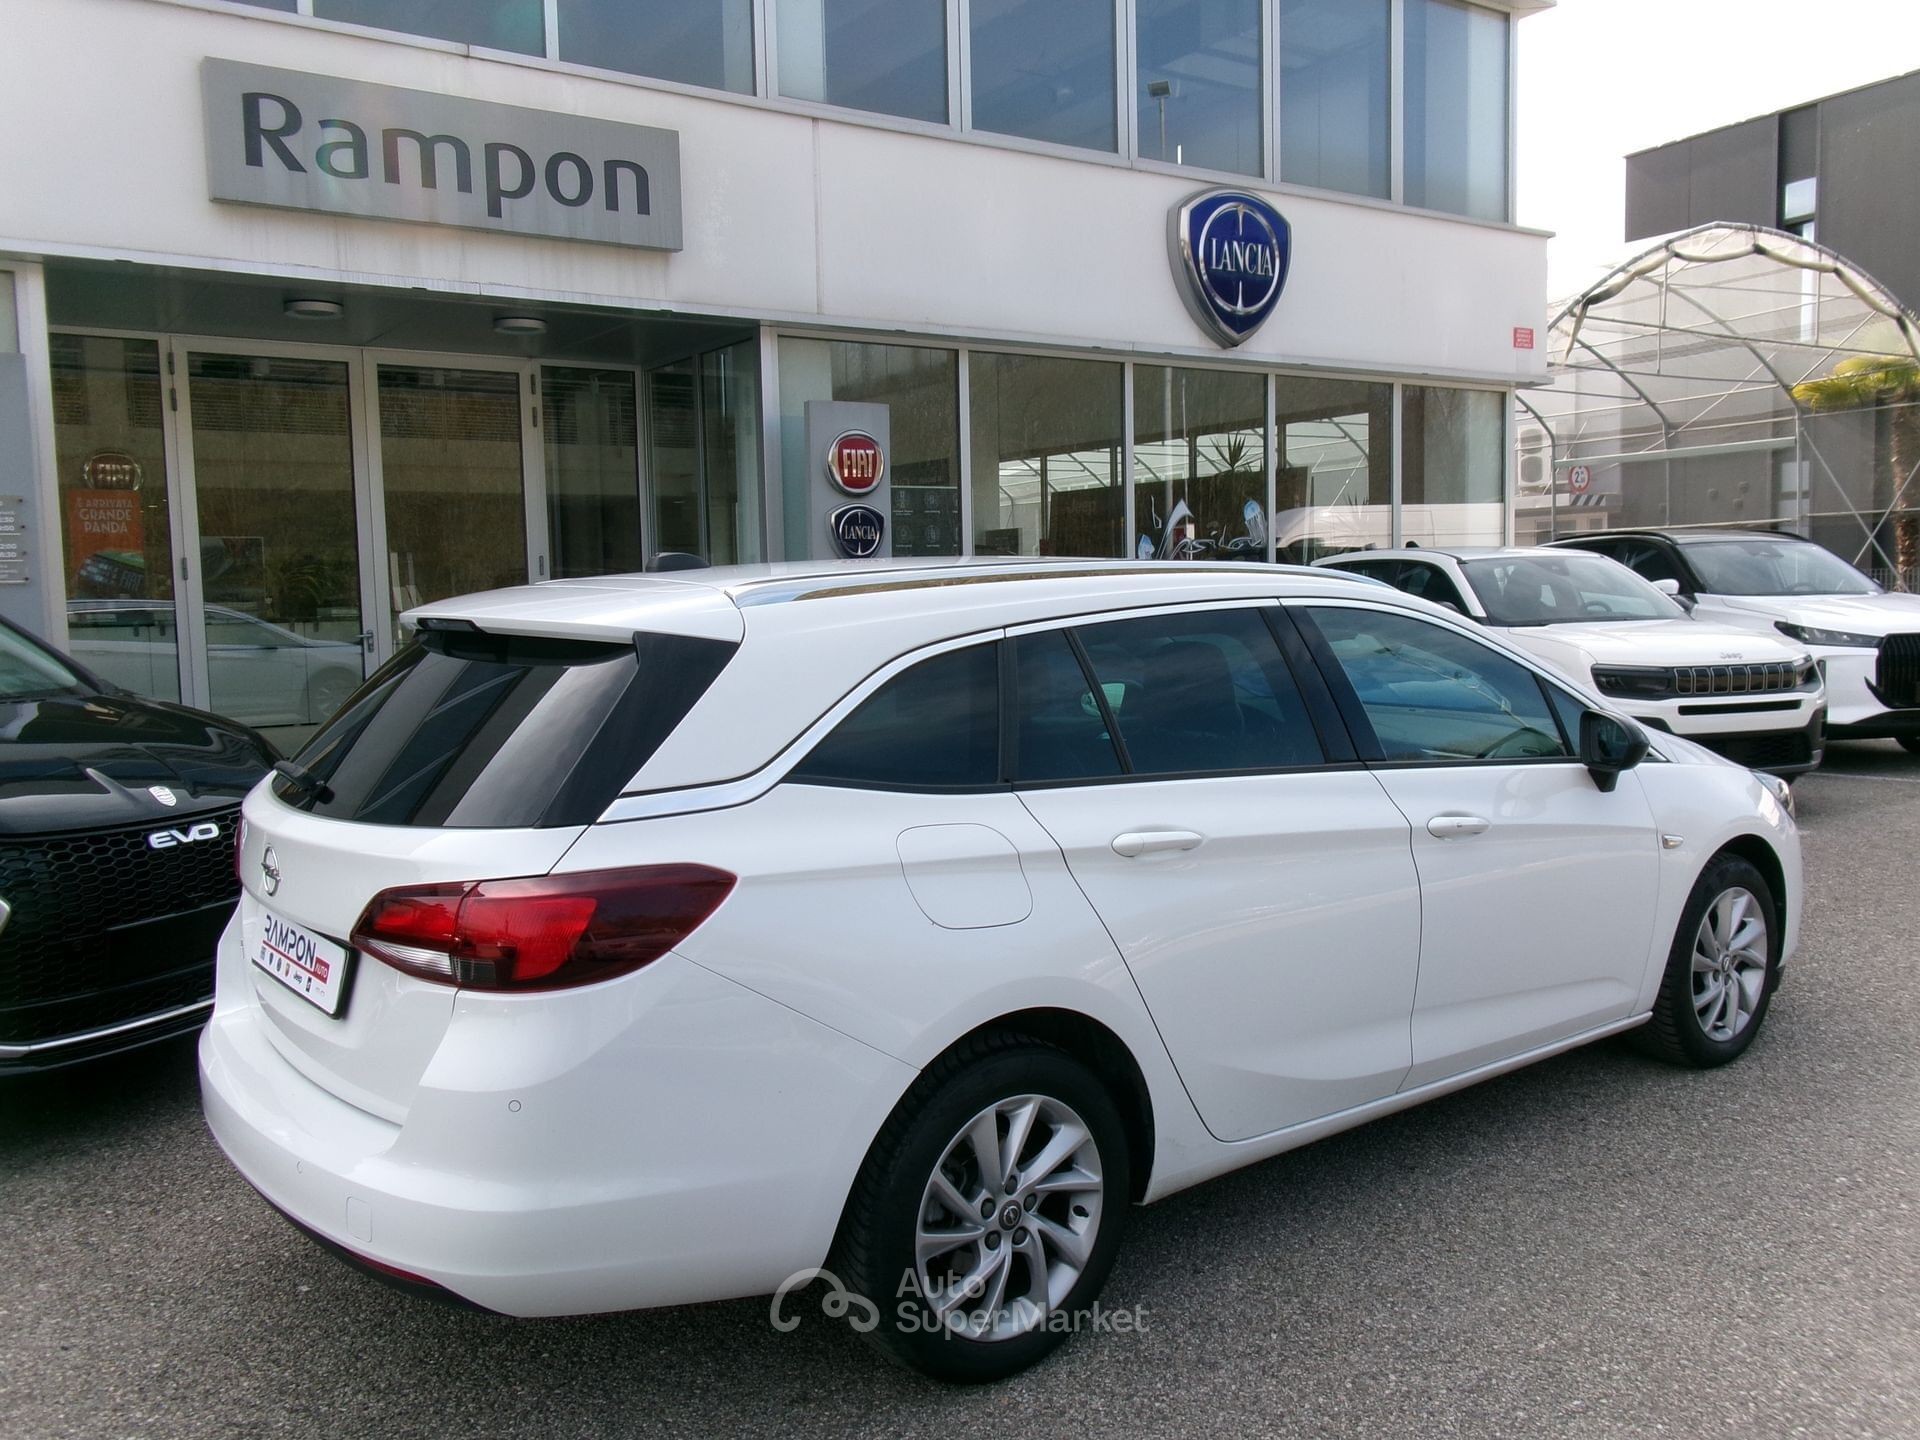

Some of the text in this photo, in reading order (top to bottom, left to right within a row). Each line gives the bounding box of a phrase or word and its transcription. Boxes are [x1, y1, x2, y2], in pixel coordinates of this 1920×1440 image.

[241, 91, 652, 219] Rampon
[1211, 237, 1274, 277] LANCIA
[842, 448, 875, 478] FIAT
[79, 508, 132, 521] GRANDE
[84, 521, 128, 533] PANDA
[844, 525, 877, 540] LANCIA
[149, 823, 219, 849] EVO
[264, 914, 317, 969] RAMPON
[315, 963, 328, 978] AUTO
